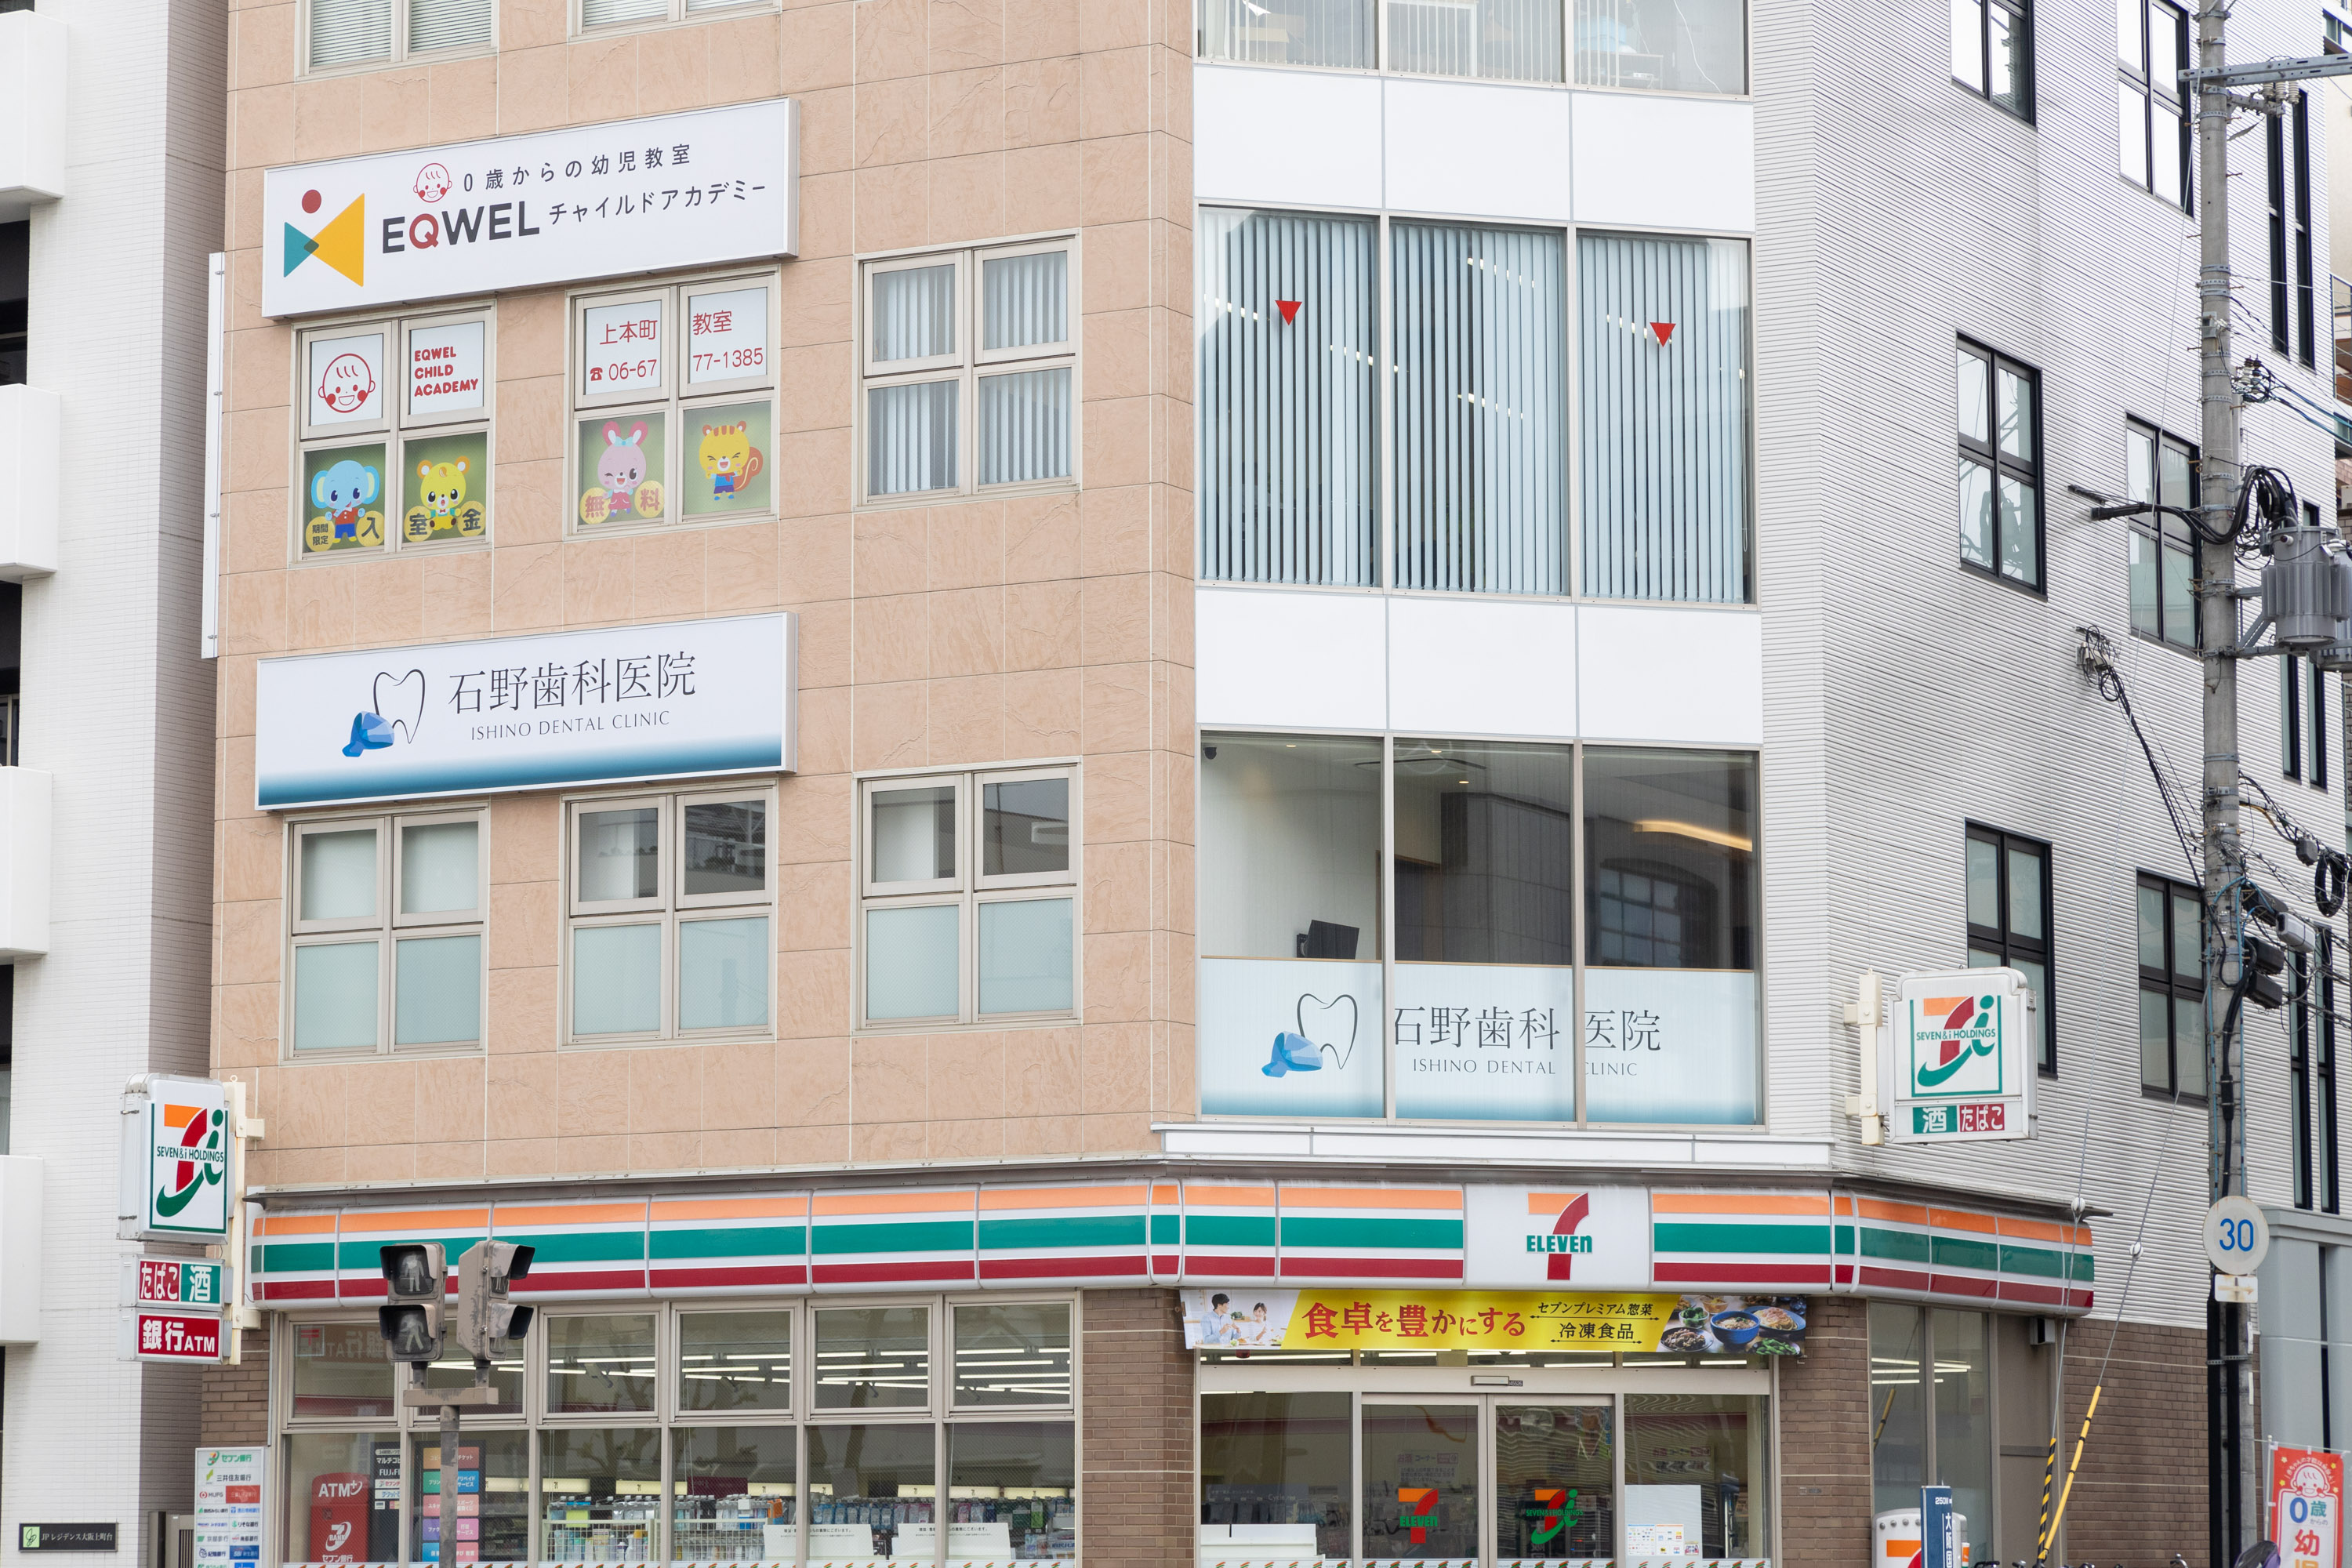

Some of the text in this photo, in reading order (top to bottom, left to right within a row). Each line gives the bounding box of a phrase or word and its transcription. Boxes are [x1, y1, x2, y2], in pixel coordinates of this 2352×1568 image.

[463, 143, 690, 192] 0歳からの幼児教室
[382, 180, 766, 254] EQWEL チャイルドアカデミー
[599, 310, 733, 346] 上本町 教室
[414, 347, 457, 362] EQWEL
[608, 347, 764, 381] 06-67 77-1385
[414, 364, 454, 379] CHILD
[414, 378, 478, 397] ACADEMY
[448, 651, 696, 714] 石野歯科医院
[471, 710, 670, 741] ISHINO DENTAL CLINIC
[1953, 1029, 1996, 1039] HOLDINGS
[1414, 1058, 1477, 1073] ISHINO
[1488, 1060, 1555, 1074] DENTAL
[1922, 1105, 2003, 1134] 酒 たばこ
[188, 1147, 224, 1163] HOLDINGS
[1526, 1234, 1593, 1254] ELEVEN
[2220, 1218, 2254, 1252] 30
[140, 1263, 212, 1302] たばこ 酒
[1301, 1301, 1526, 1340] 食卓を豊かにする
[1537, 1301, 1653, 1316] セブンプレミアム惣菜
[1559, 1322, 1635, 1340] 冷凍食品
[1399, 1515, 1438, 1527] ELEVEN
